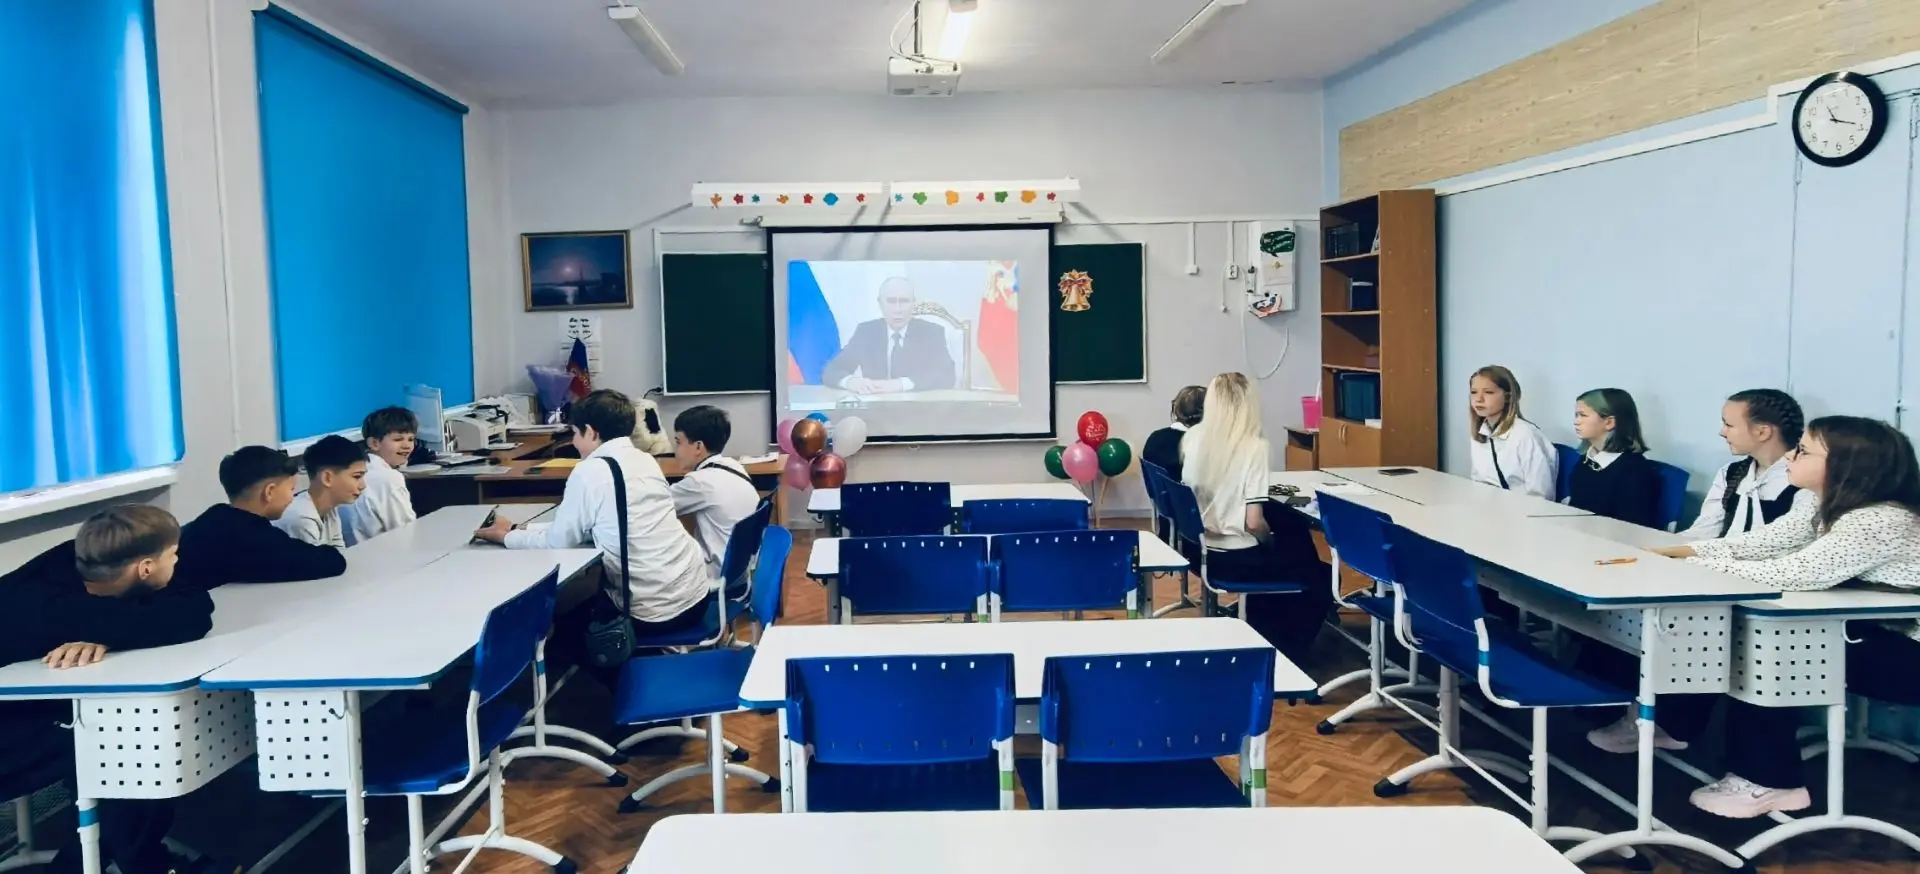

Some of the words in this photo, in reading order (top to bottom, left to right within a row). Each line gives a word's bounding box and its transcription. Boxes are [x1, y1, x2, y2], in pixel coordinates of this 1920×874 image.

[1805, 120, 1812, 130] 9
[1822, 140, 1829, 148] 7
[1849, 134, 1855, 145] 5
[1835, 142, 1842, 152] 6
